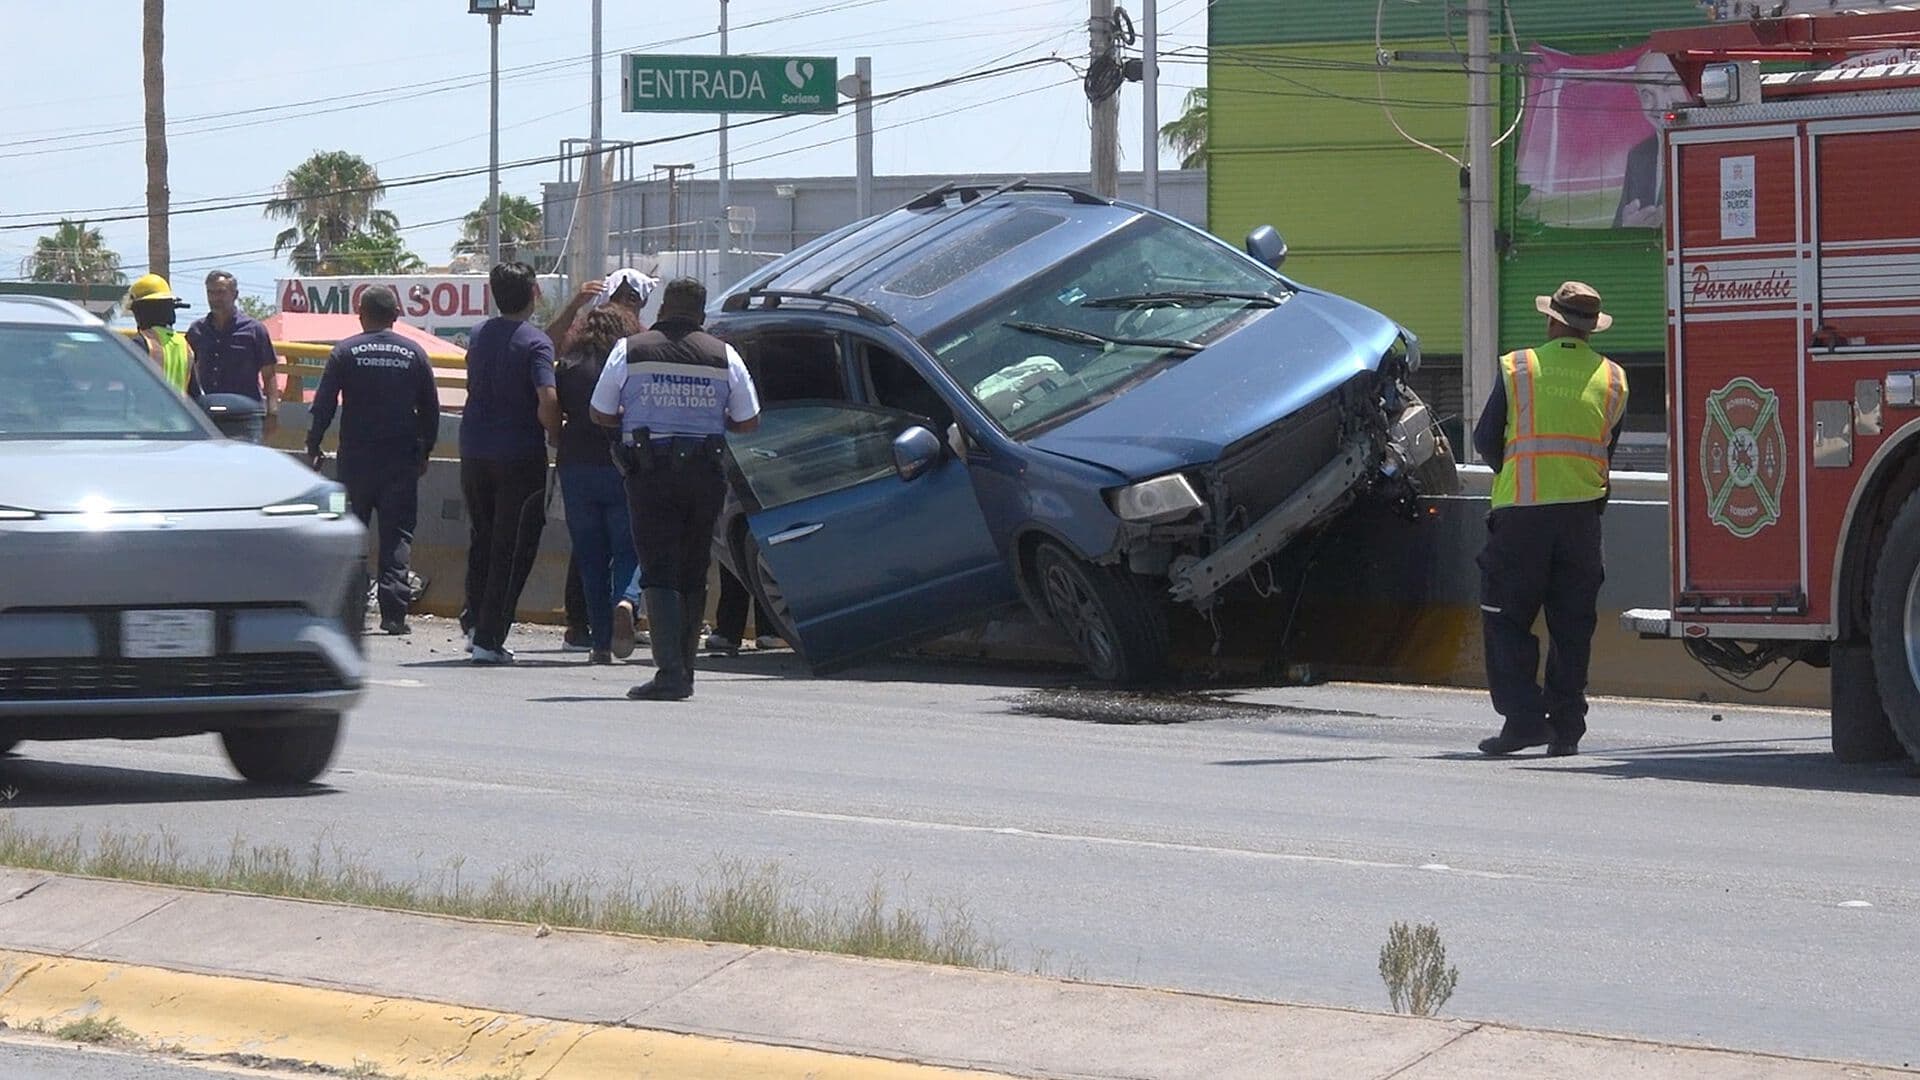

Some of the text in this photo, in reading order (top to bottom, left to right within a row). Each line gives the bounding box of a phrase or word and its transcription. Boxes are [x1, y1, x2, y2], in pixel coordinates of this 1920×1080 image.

[638, 69, 765, 99] ENTRADA
[781, 92, 820, 104] Soriana
[1691, 265, 1791, 305] Paramedic
[351, 343, 416, 360] BOMBEROS
[652, 373, 711, 387] VIALIDAD
[640, 396, 717, 408] Y VIALIDAD
